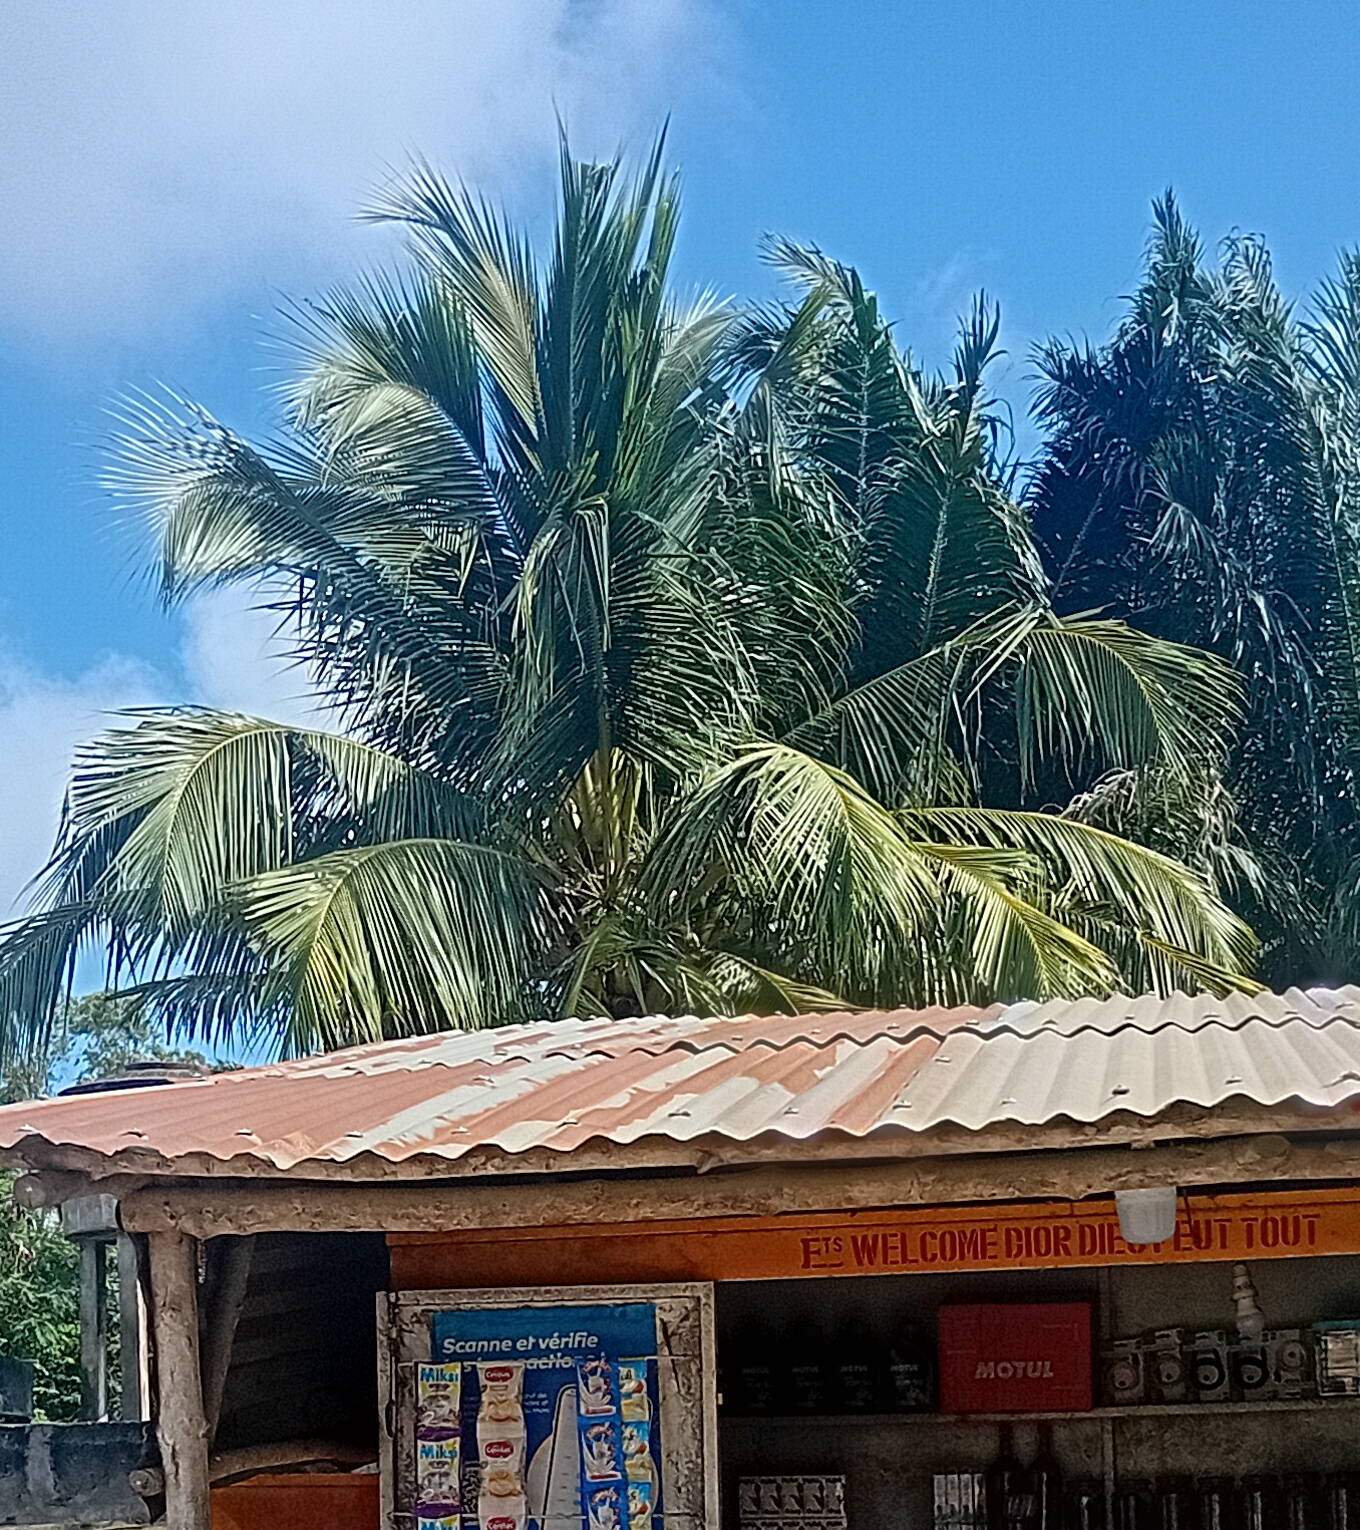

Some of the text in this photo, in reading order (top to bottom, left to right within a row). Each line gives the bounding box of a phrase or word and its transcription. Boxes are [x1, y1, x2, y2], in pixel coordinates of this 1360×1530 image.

[851, 1224, 998, 1267] WELCOME
[1005, 1223, 1072, 1259] DIOR
[1079, 1222, 1147, 1256] DIE
[1151, 1219, 1232, 1253] EUT
[1240, 1213, 1321, 1249] TOUT
[442, 1331, 598, 1354] Scanne et vérifie
[976, 1360, 1054, 1380] MOTUL
